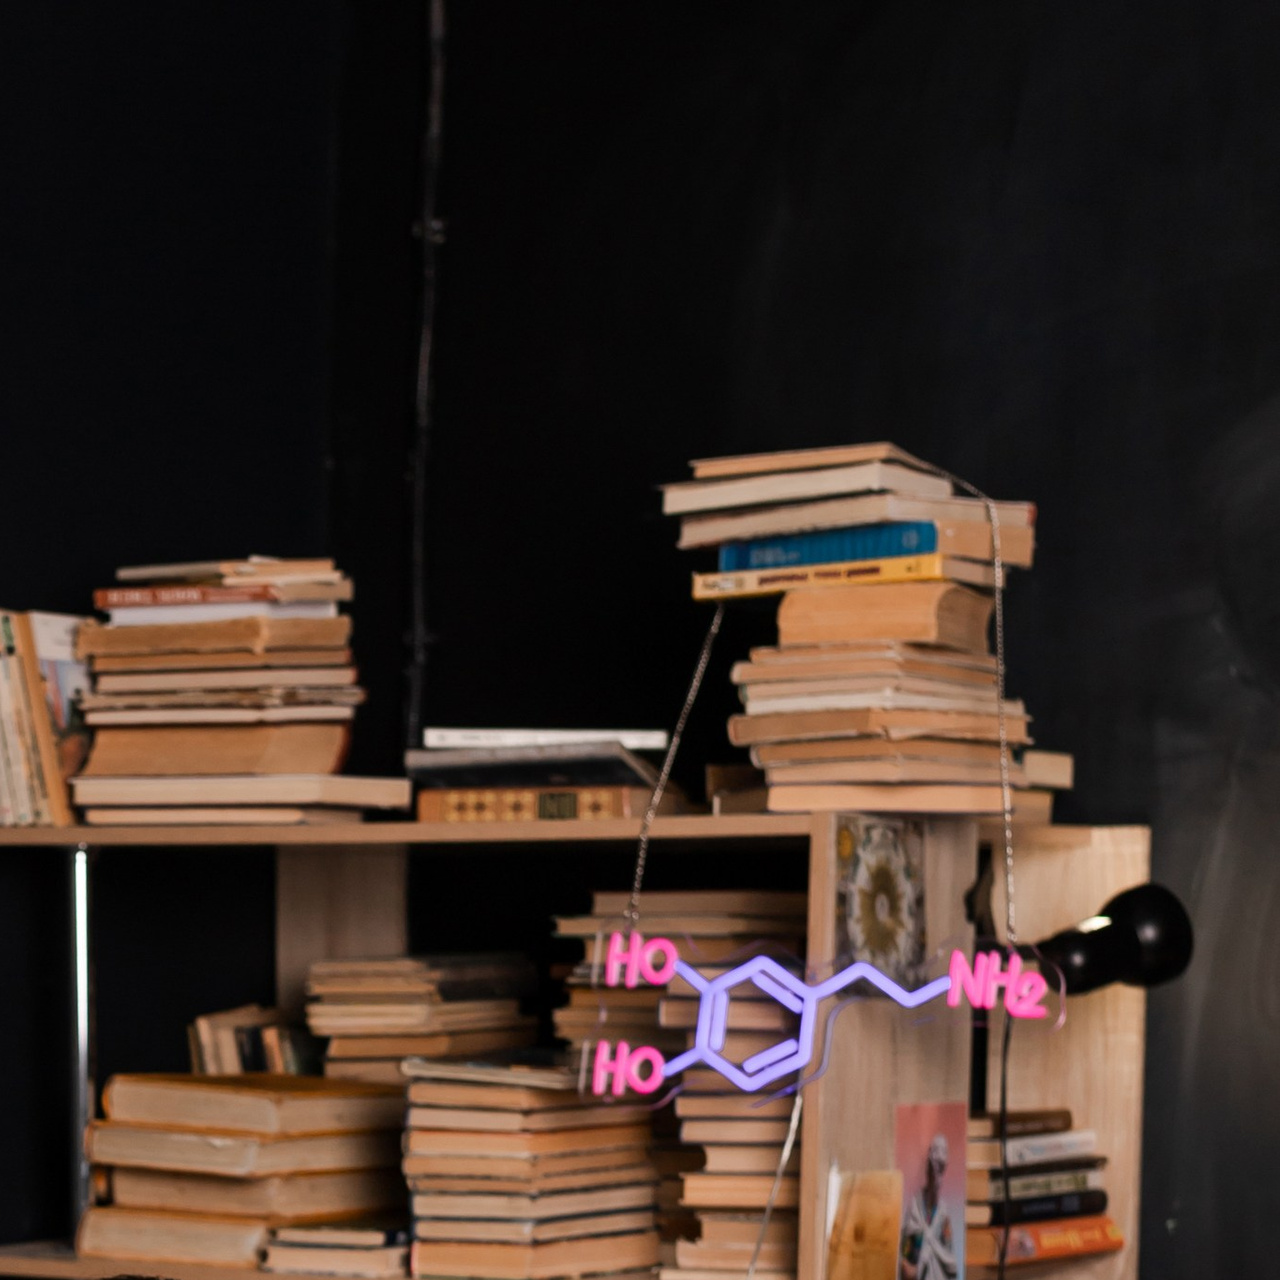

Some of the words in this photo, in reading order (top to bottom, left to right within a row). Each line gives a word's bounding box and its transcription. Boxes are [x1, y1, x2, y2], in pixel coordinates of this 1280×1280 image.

[605, 930, 679, 988] HO
[947, 948, 1048, 1018] NH2
[592, 1039, 666, 1096] HO
